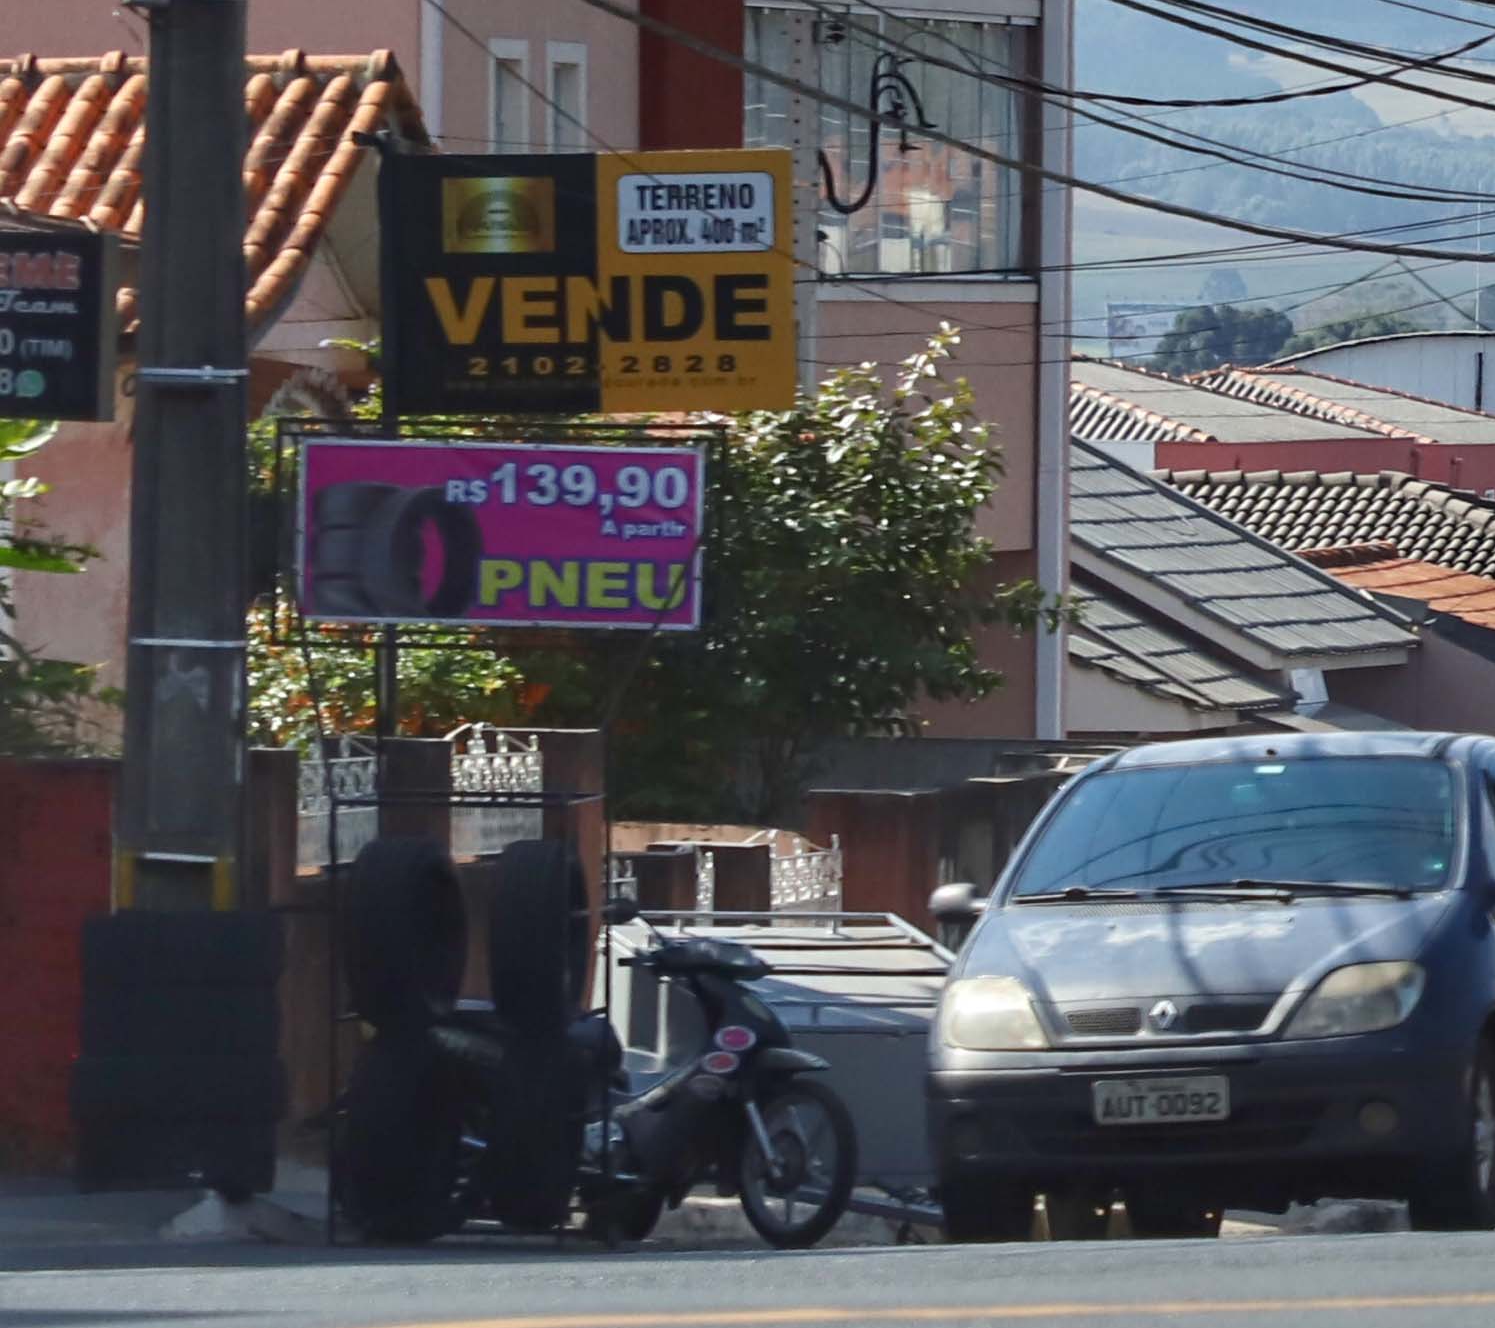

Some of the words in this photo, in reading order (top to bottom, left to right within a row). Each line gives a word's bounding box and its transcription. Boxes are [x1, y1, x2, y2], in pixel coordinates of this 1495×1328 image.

[635, 183, 754, 210] TERRENO
[626, 218, 695, 246] APROX.
[424, 273, 773, 346] VENDE
[601, 519, 618, 536] A
[622, 520, 688, 540] partir
[478, 558, 687, 611] PNEU
